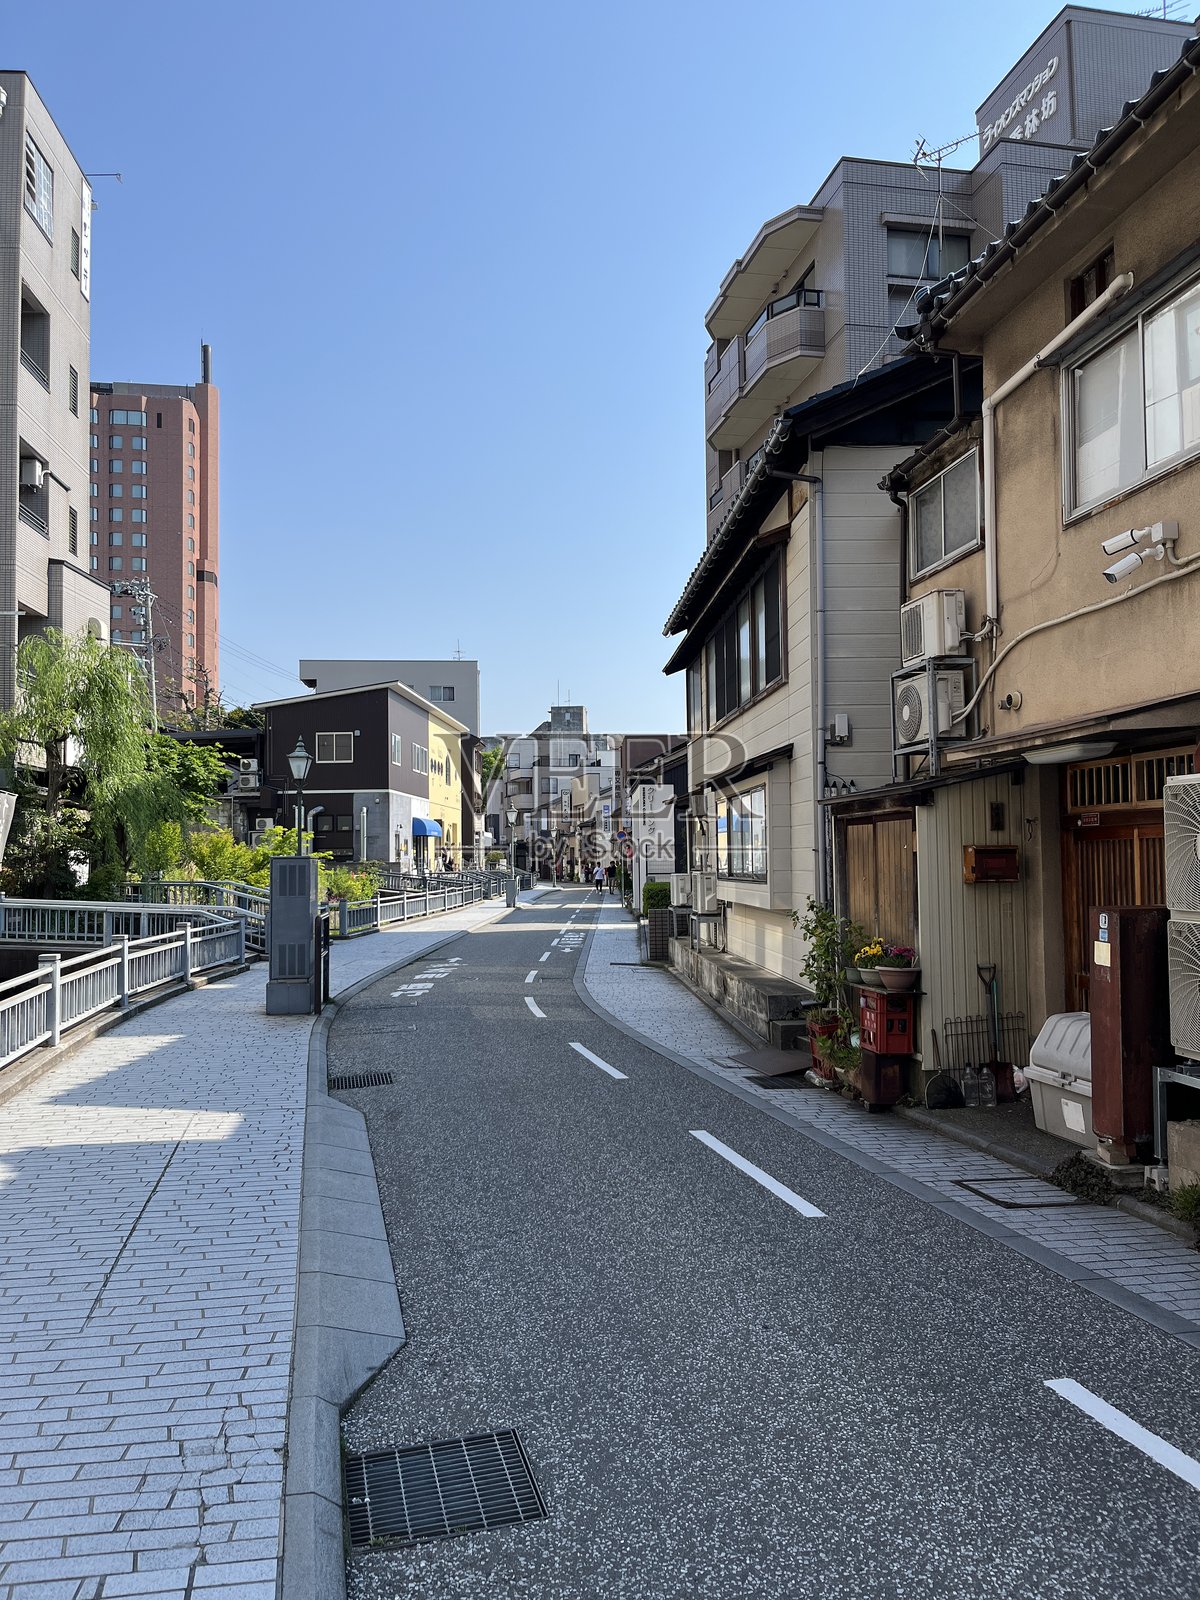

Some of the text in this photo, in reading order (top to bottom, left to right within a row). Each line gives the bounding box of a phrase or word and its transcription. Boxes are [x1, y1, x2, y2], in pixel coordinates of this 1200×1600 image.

[982, 57, 1058, 149] ライオンズマンション
